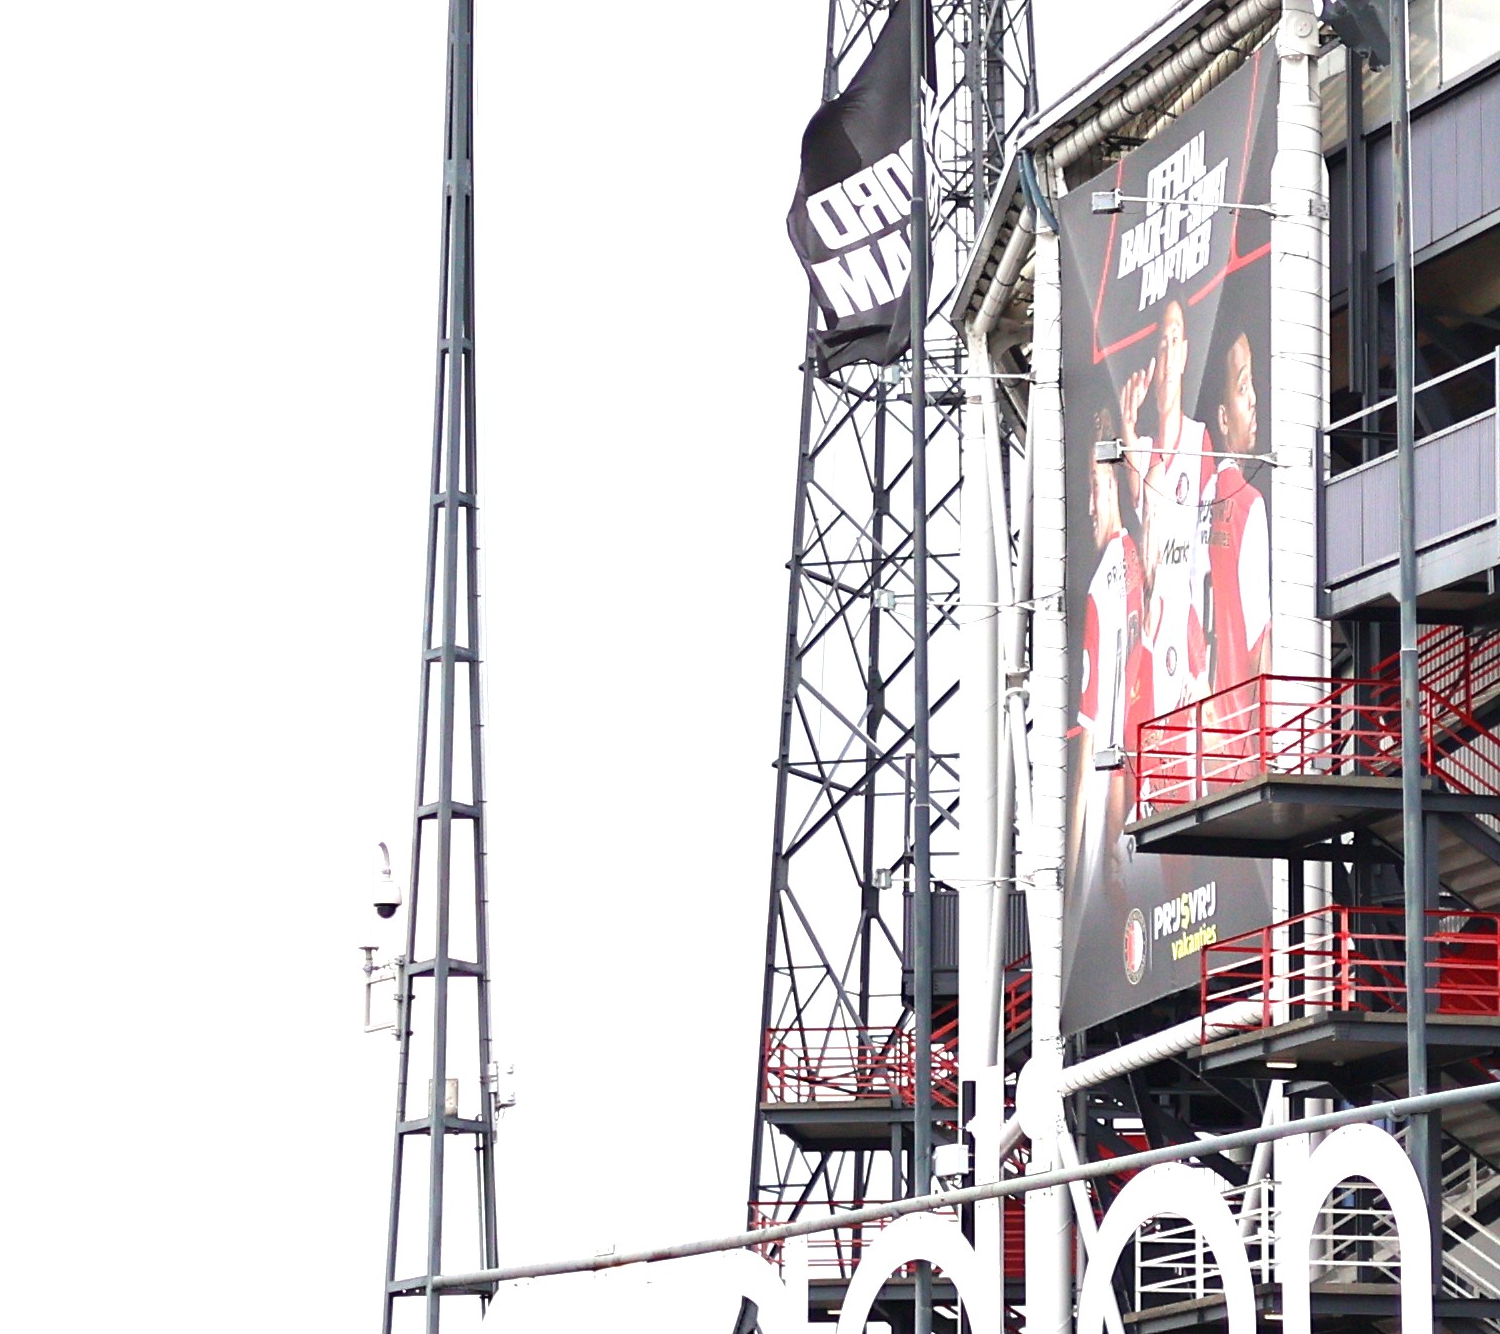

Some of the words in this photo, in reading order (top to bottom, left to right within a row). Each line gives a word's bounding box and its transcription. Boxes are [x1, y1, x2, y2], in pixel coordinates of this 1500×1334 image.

[1145, 129, 1207, 217] OFFICIAL
[1138, 219, 1213, 312] PARTNER
[1171, 922, 1218, 961] vakanties
